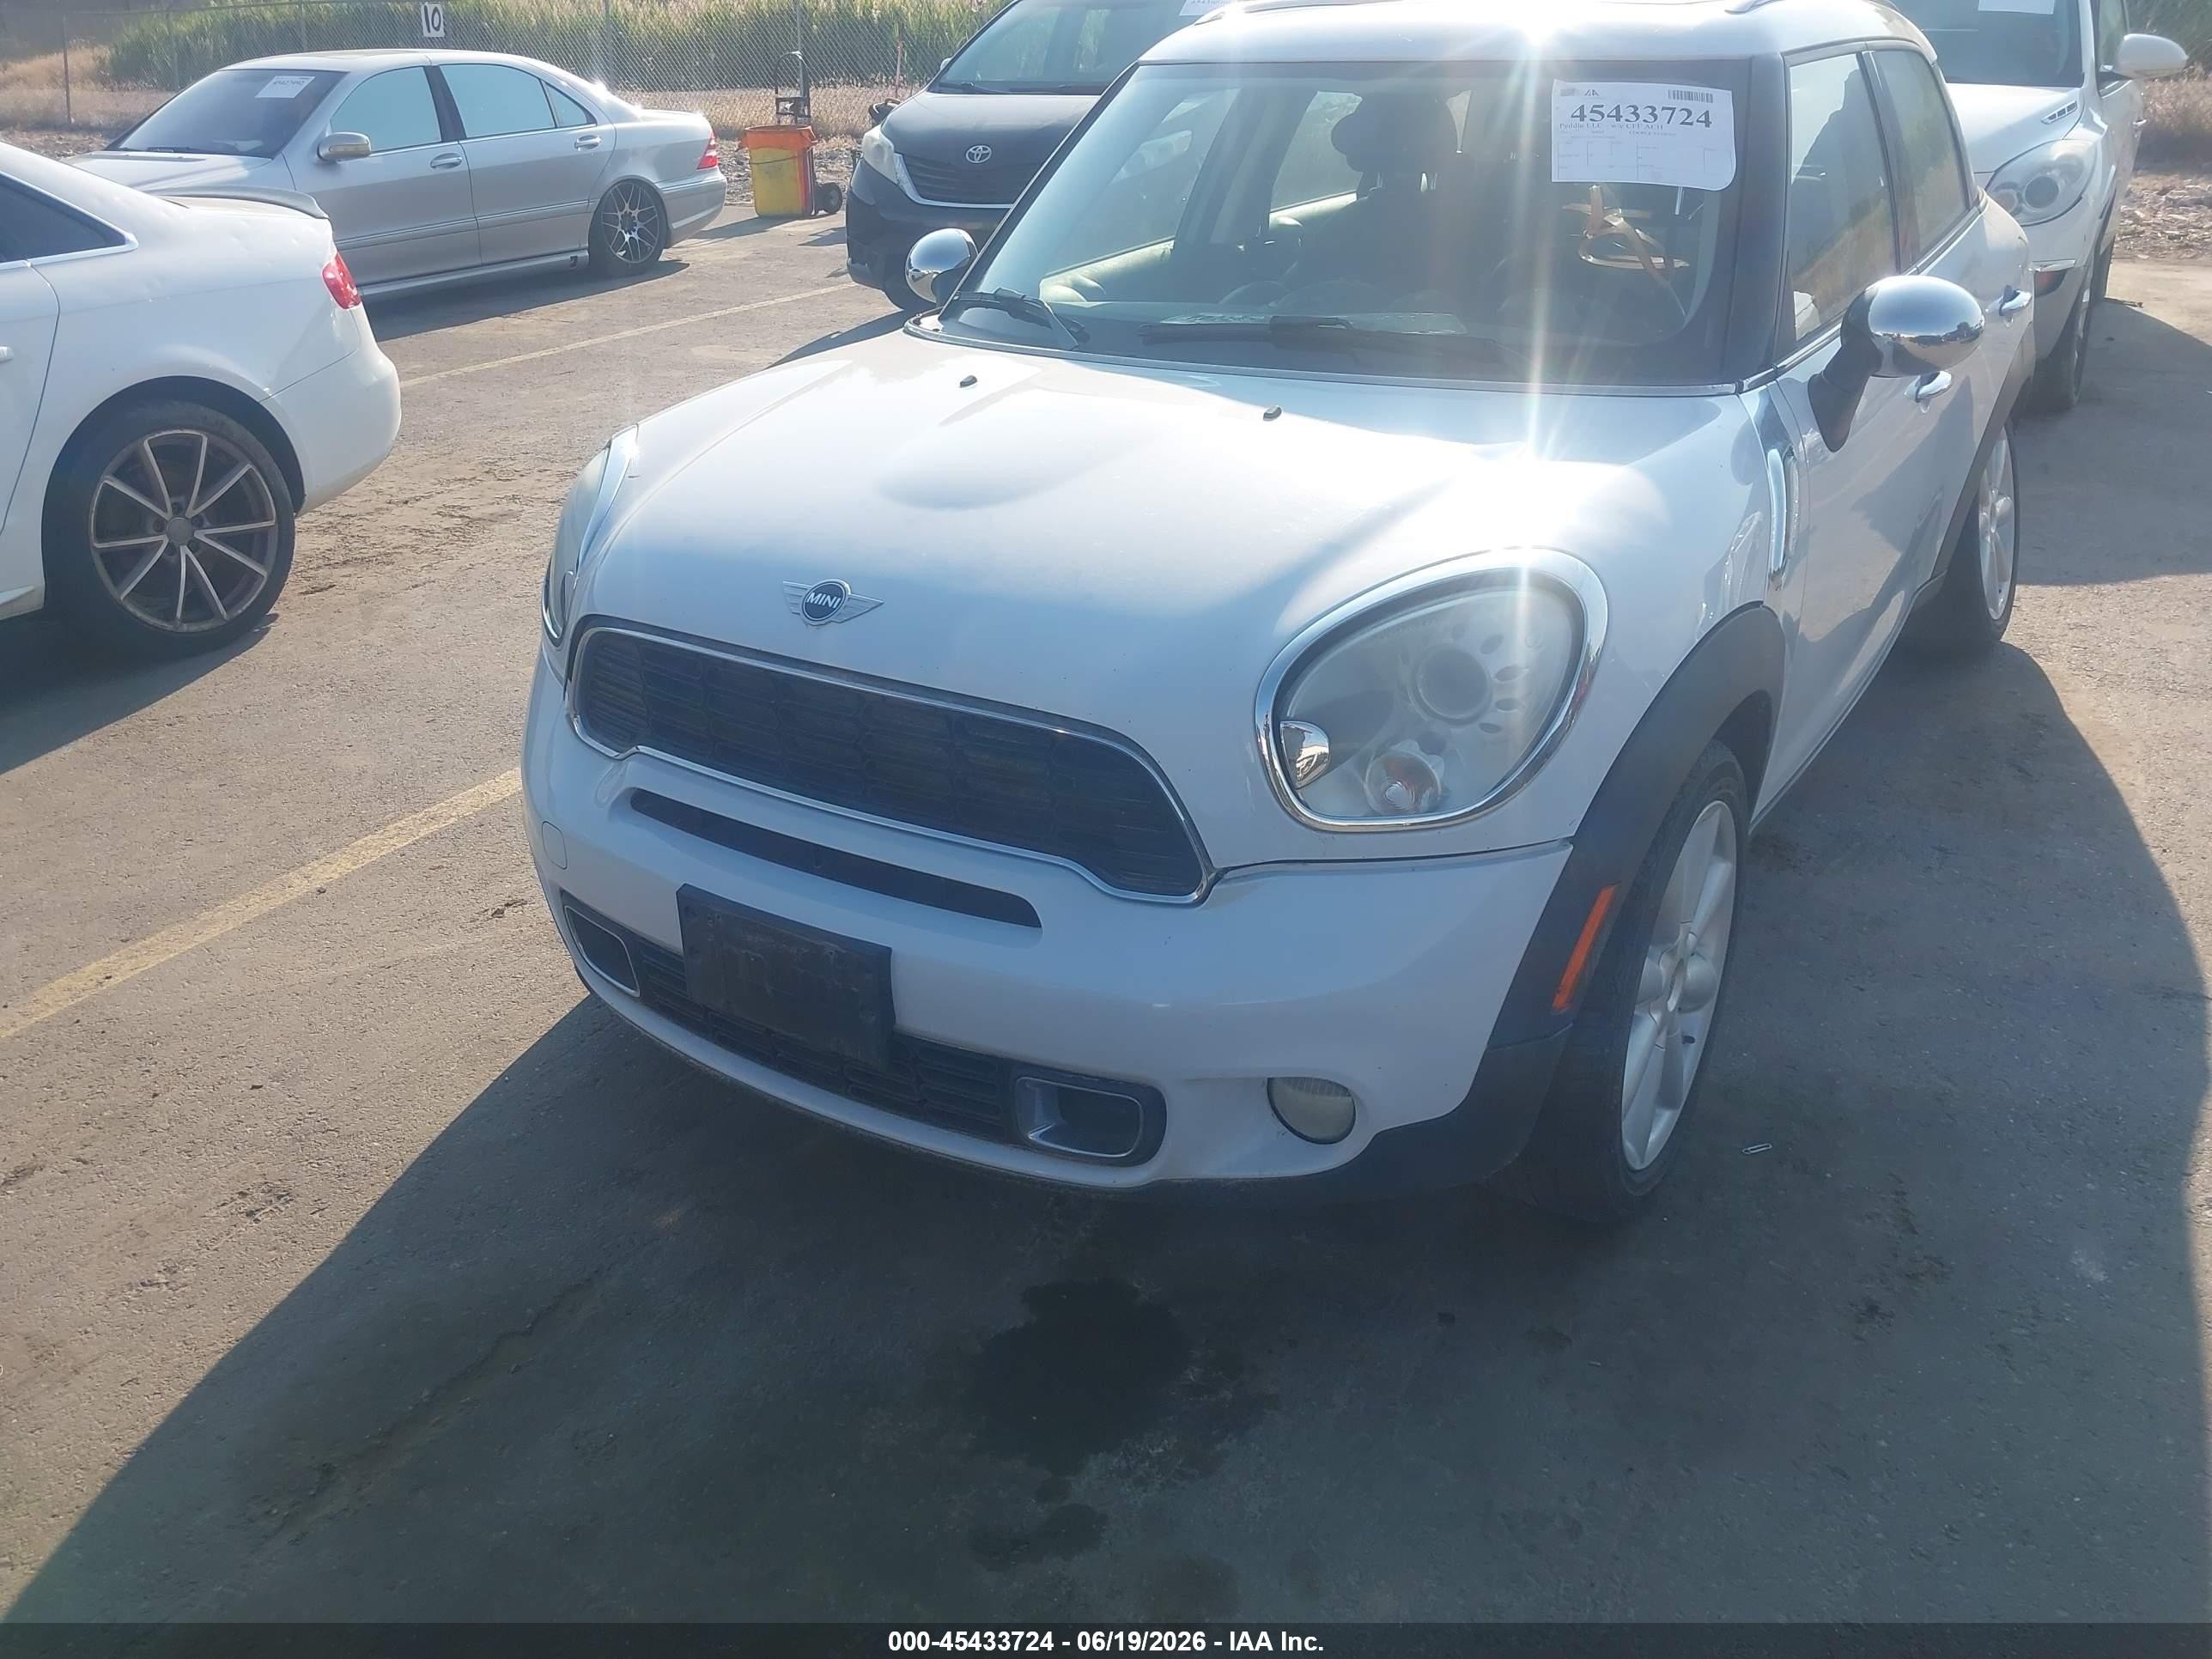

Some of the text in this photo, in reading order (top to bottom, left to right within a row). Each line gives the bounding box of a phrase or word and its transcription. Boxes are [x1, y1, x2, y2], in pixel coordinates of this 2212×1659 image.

[423, 4, 441, 33] 10
[1570, 104, 1713, 128] 45433724
[806, 592, 842, 609] MINI
